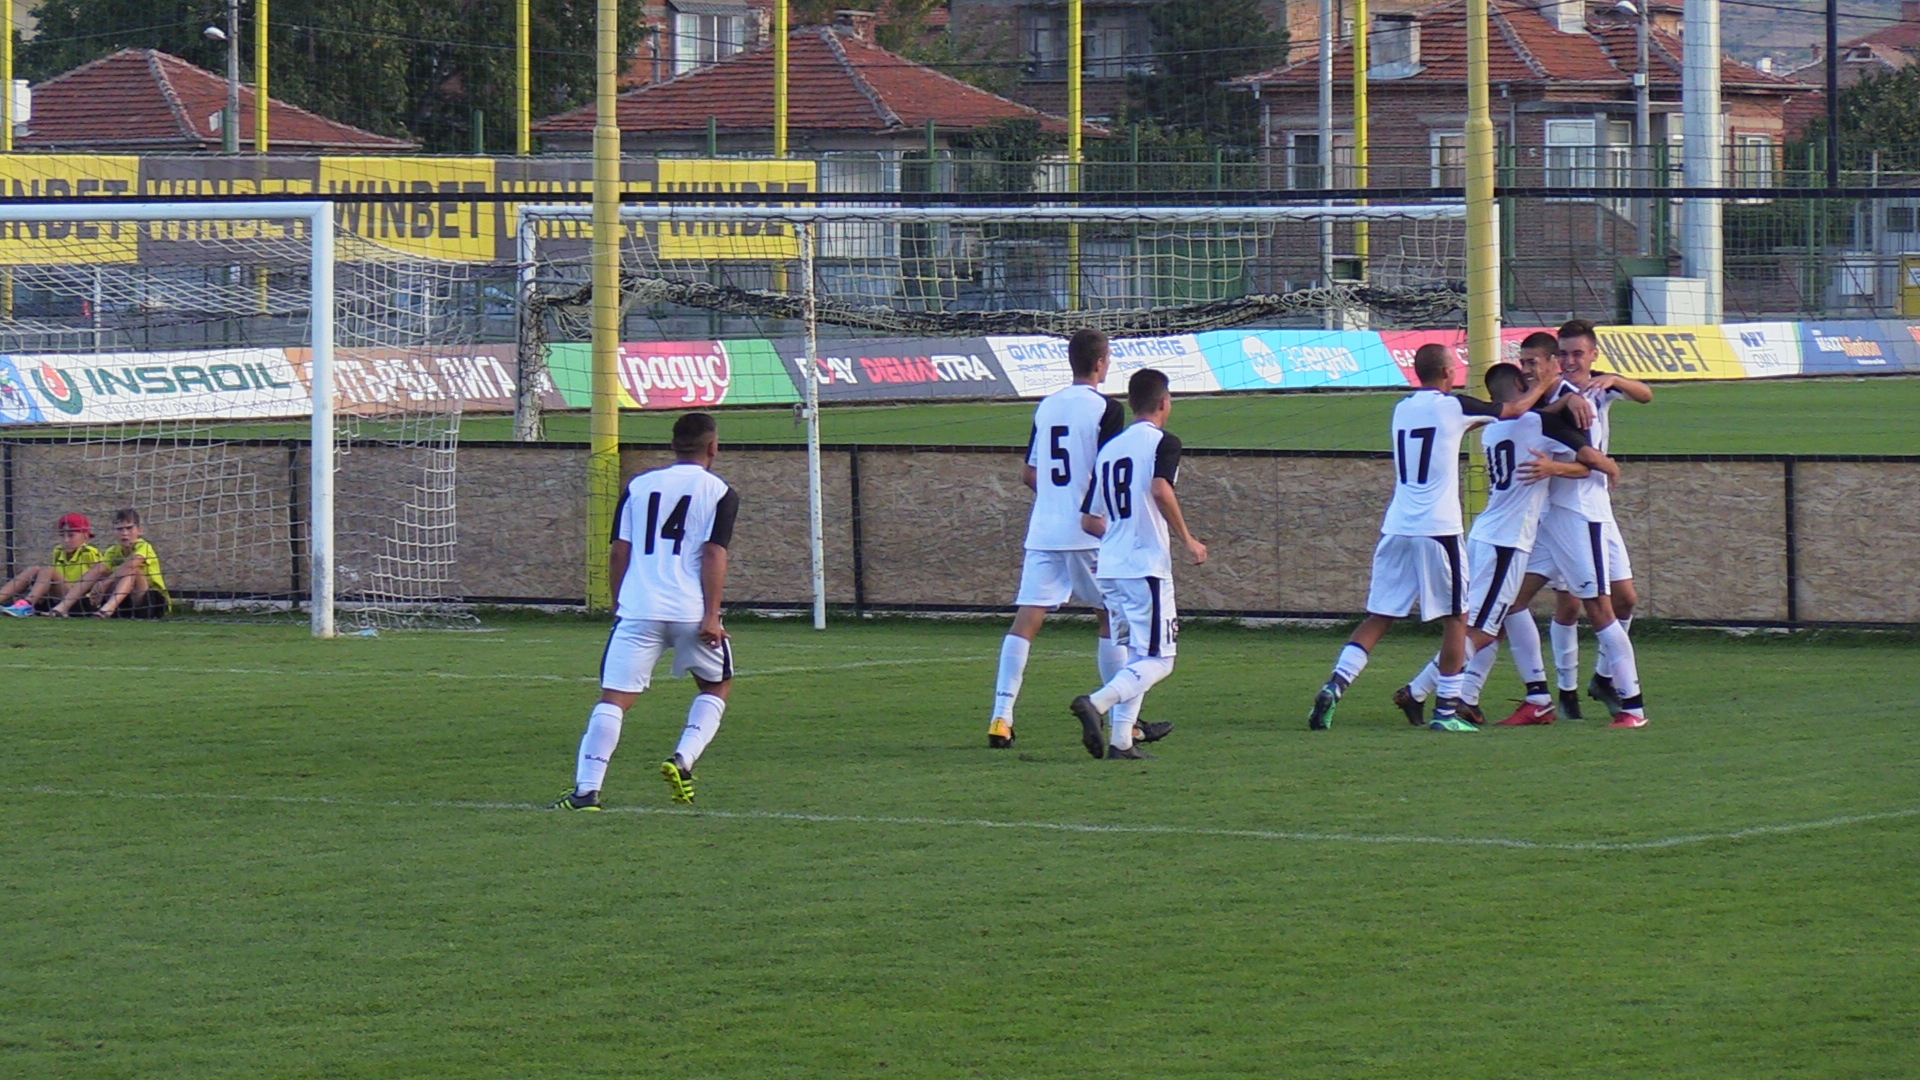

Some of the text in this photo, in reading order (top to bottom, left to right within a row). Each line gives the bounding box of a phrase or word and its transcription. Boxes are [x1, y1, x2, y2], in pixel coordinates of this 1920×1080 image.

[329, 180, 486, 239] WINBET
[84, 362, 292, 396] INSAOIL
[1006, 343, 1070, 362] ФИЛКА
[1597, 332, 1710, 373] WINBET
[1051, 425, 1071, 487] 5
[1397, 427, 1437, 485] 17
[1486, 439, 1515, 496] 10
[1102, 456, 1134, 522] 18
[644, 491, 693, 556] 14
